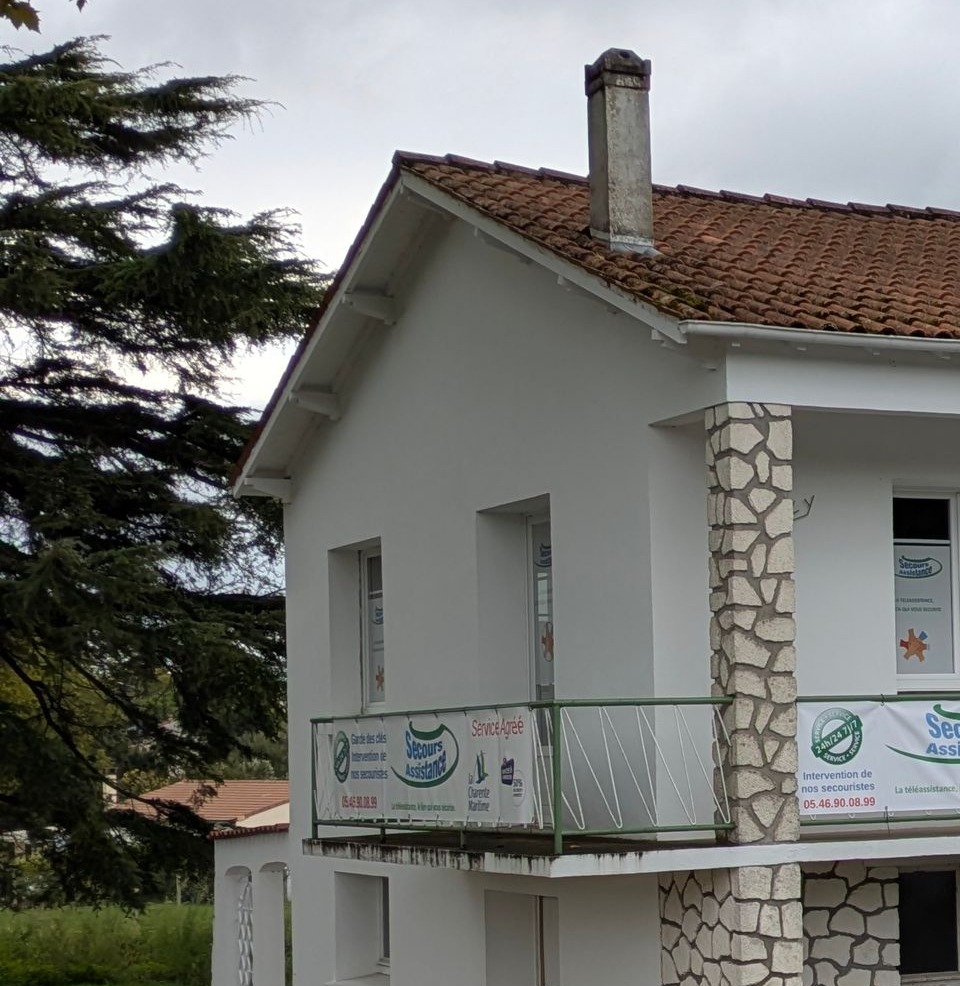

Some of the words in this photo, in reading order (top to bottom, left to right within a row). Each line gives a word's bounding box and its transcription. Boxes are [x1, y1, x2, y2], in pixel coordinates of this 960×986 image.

[898, 558, 929, 568] Secours
[472, 719, 500, 737] Service
[500, 716, 524, 739] Agréé
[406, 730, 443, 760] Secours
[815, 731, 842, 753] 24h/24
[406, 750, 446, 780] Assistance
[803, 770, 858, 780] Intervention
[861, 770, 872, 778] de
[468, 786, 490, 798] Charente
[822, 782, 875, 792] secouristes
[804, 797, 876, 809] 05.46.90.08.99
